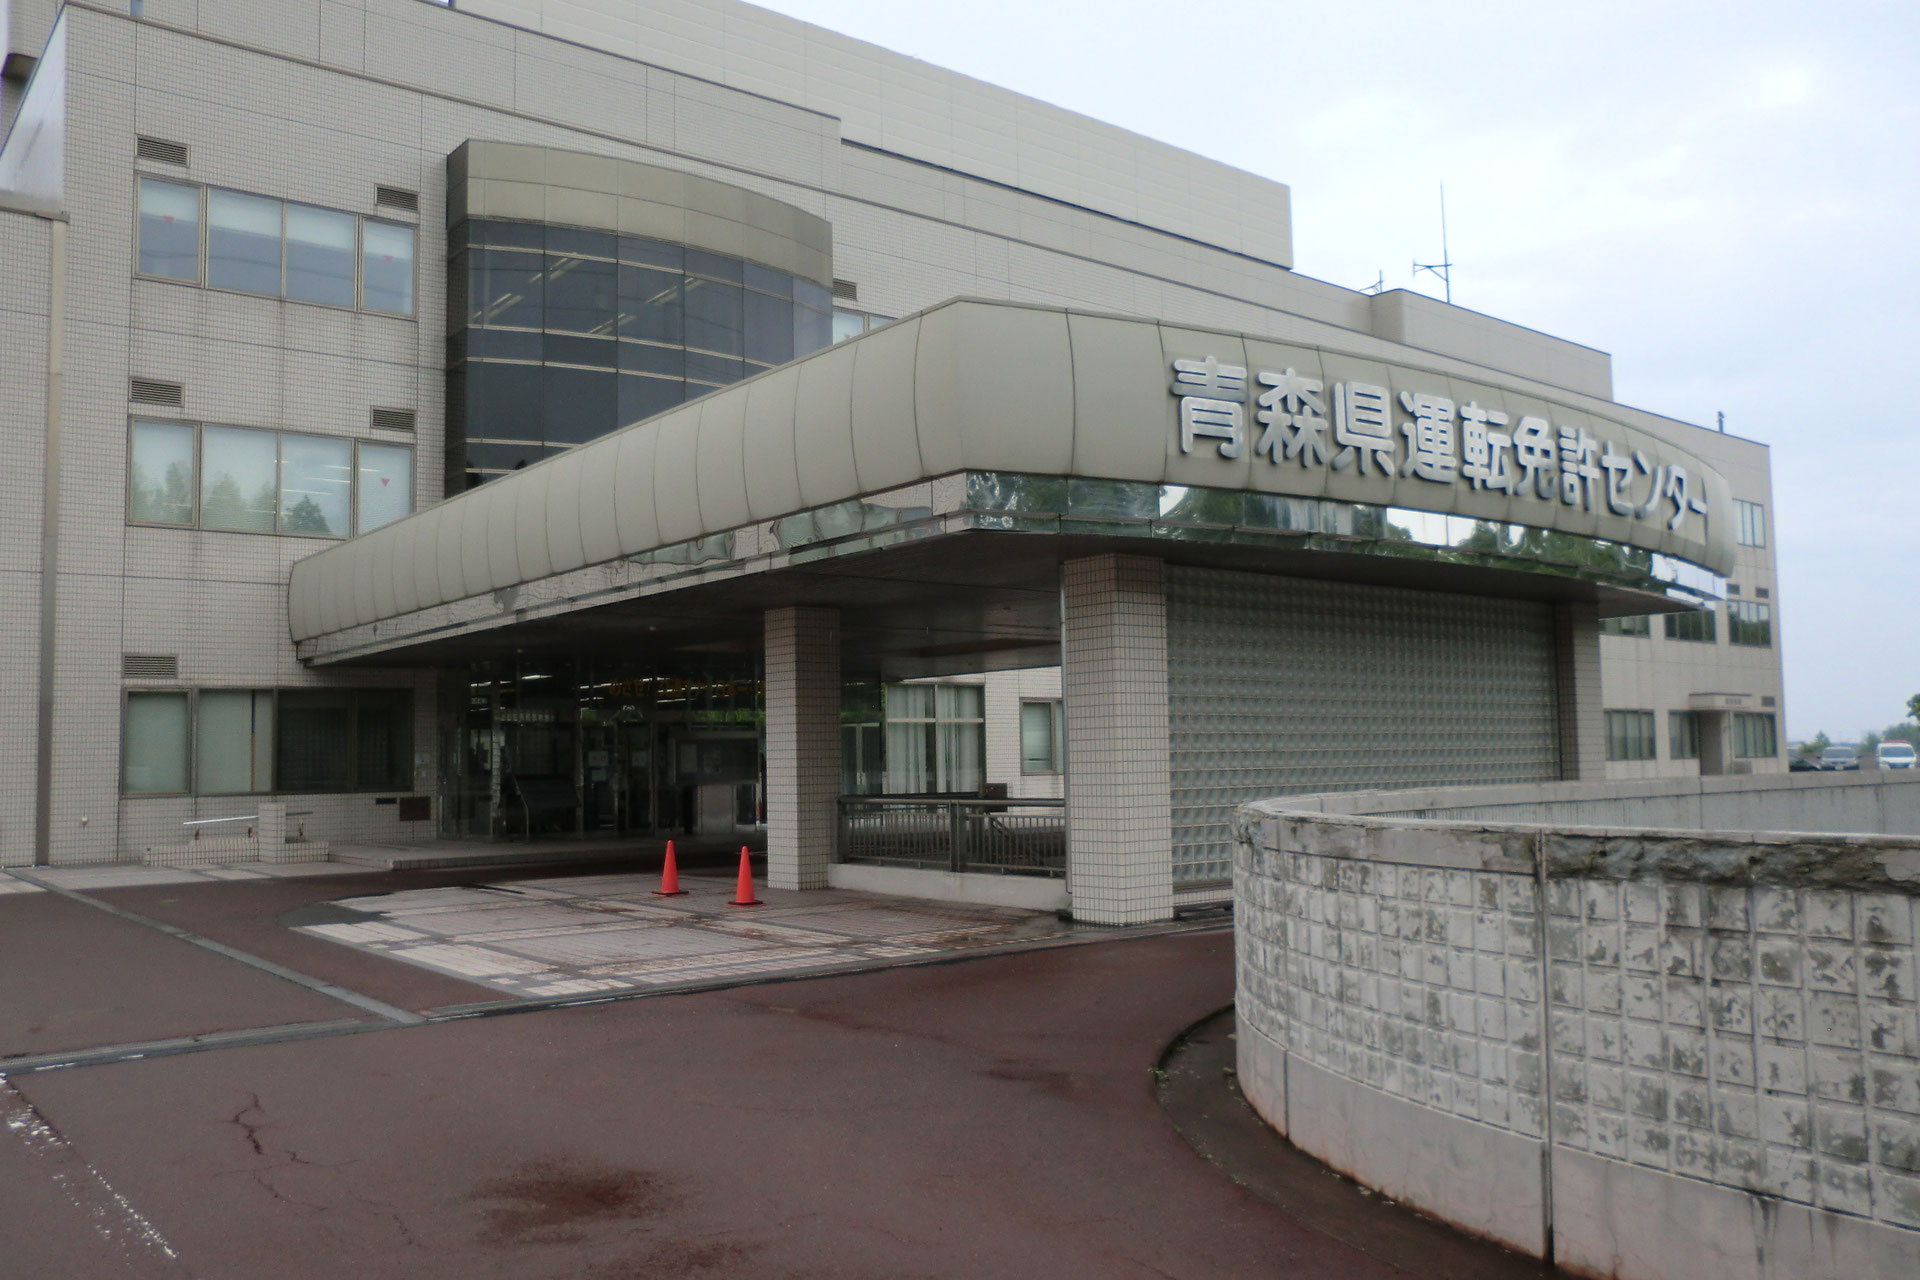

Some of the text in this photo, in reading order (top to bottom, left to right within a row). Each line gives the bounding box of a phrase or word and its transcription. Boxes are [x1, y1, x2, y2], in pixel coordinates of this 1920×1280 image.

[1171, 355, 1708, 530] 青森県運転免許センター
